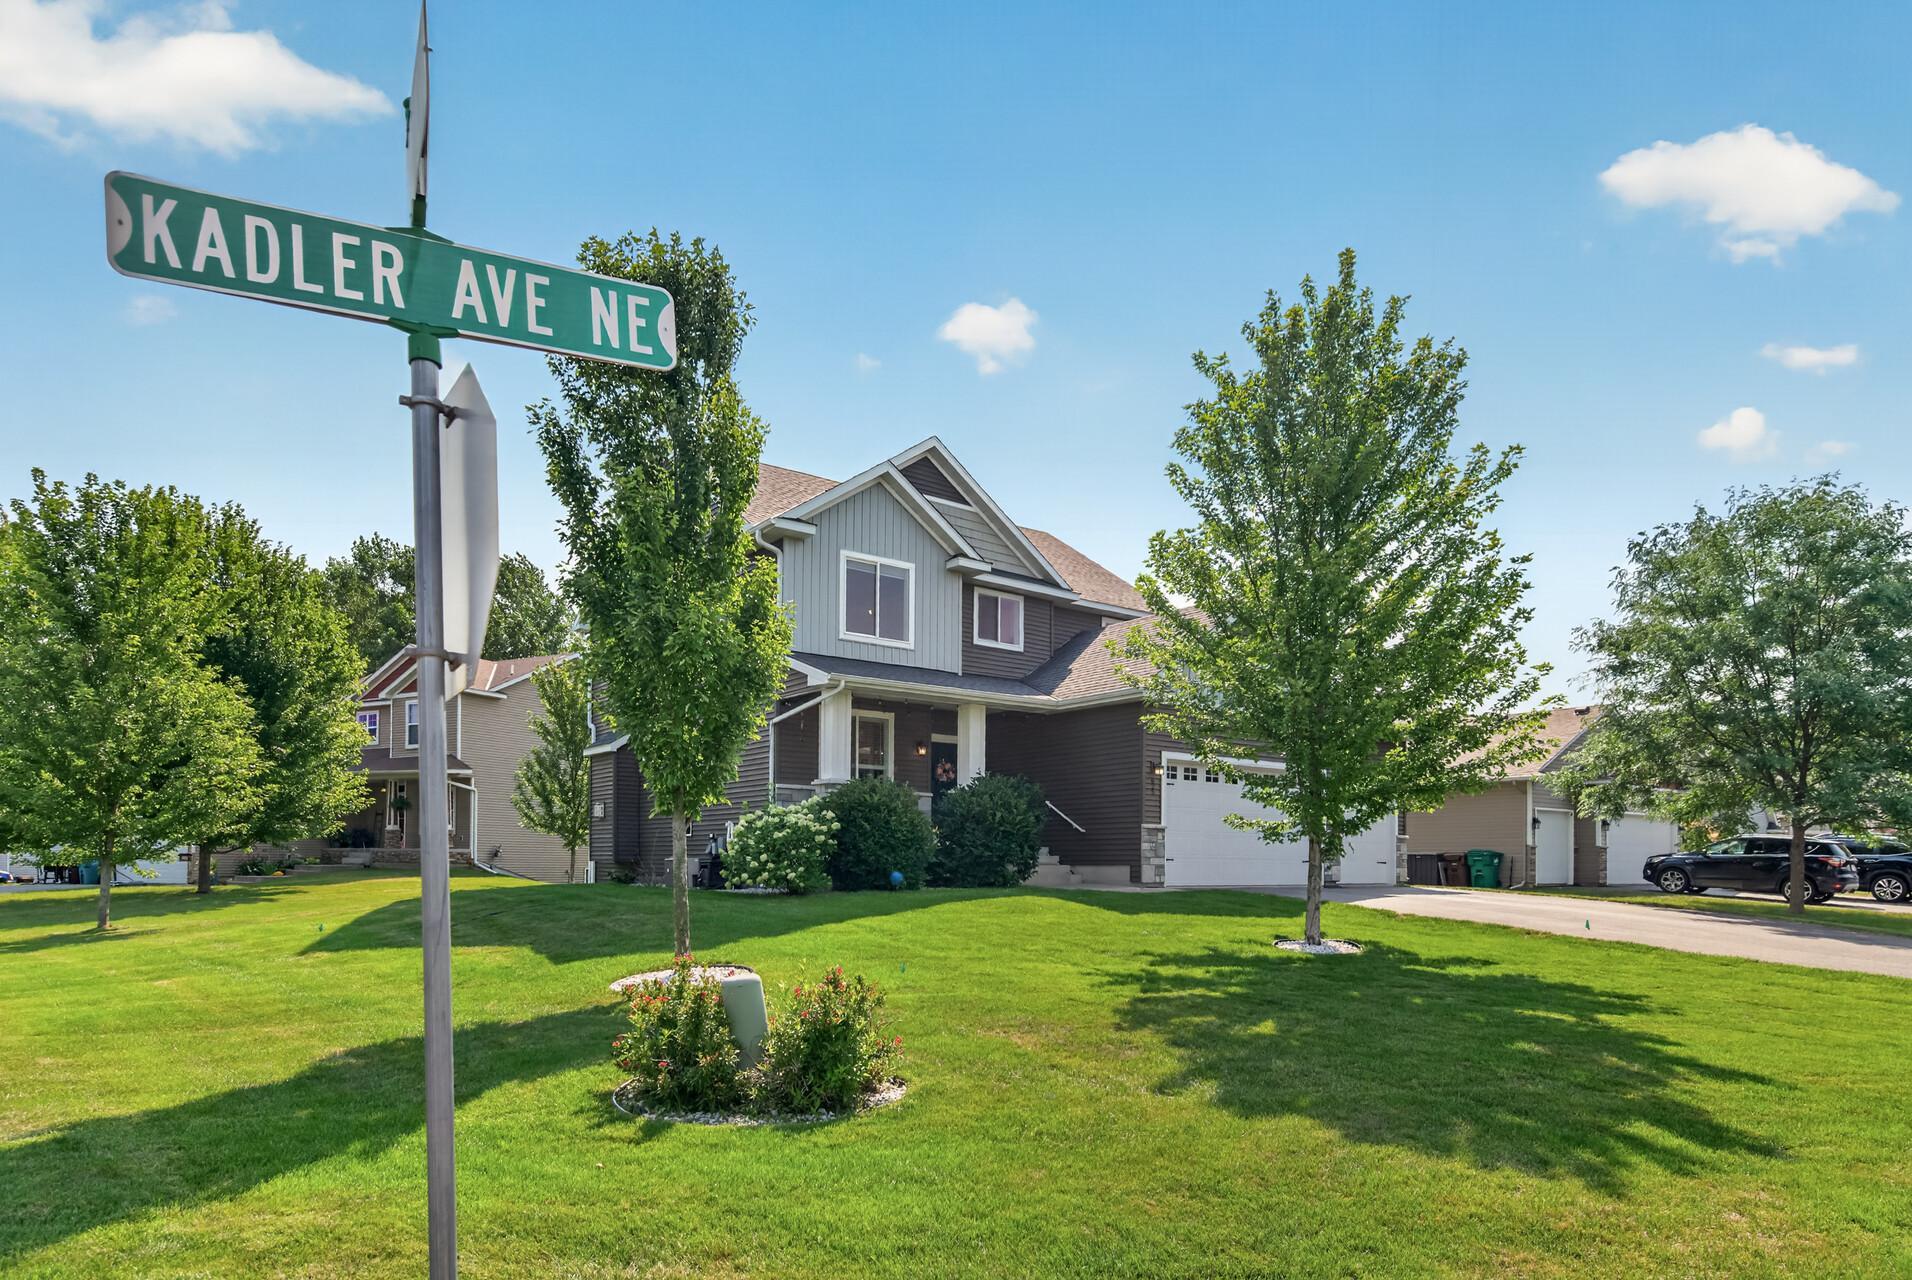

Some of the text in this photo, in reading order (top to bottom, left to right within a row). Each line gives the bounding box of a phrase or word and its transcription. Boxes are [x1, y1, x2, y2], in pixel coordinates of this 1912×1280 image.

[141, 193, 654, 356] KADLER AVE NE
